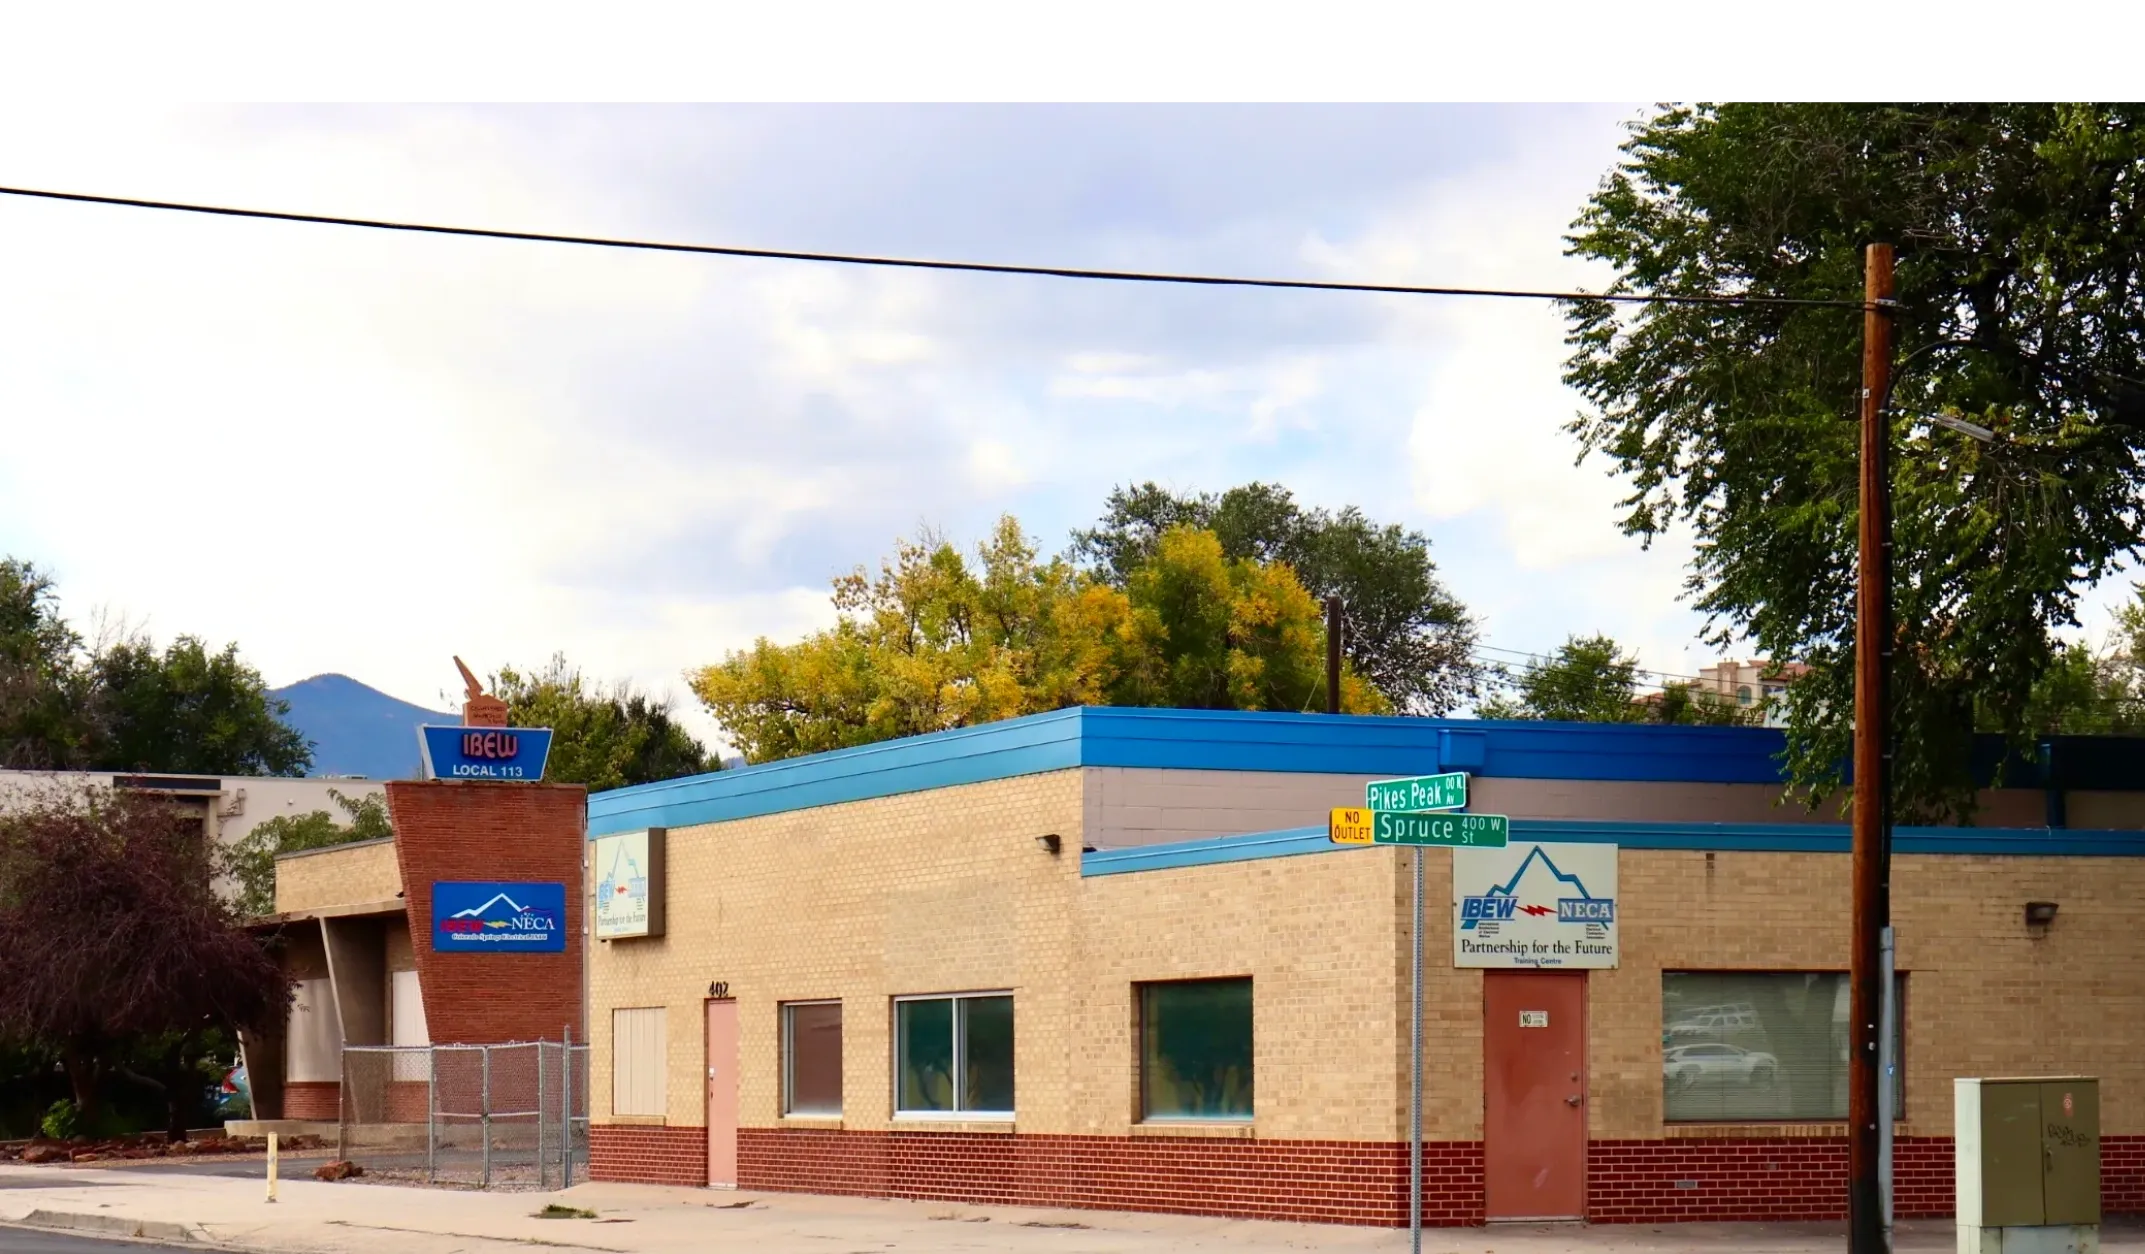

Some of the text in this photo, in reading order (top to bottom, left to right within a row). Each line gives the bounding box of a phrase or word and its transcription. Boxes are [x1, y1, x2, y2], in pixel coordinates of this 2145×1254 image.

[463, 732, 518, 758] IBEW
[453, 764, 523, 777] LOCAL 113
[1445, 776, 1455, 790] 00
[1370, 781, 1442, 810] Pikes Peak
[1345, 811, 1360, 823] NO
[1461, 817, 1501, 831] 400 W
[1334, 826, 1371, 840] OUTLET
[1380, 814, 1454, 841] Spruce
[1461, 831, 1475, 844] St
[1461, 898, 1517, 918] IBEW
[1560, 901, 1612, 918] NECA
[511, 917, 556, 930] NECA
[1461, 939, 1613, 956] Partnership for the Future
[1514, 957, 1539, 965] Training
[708, 981, 729, 997] 402
[1522, 1014, 1532, 1024] NO
